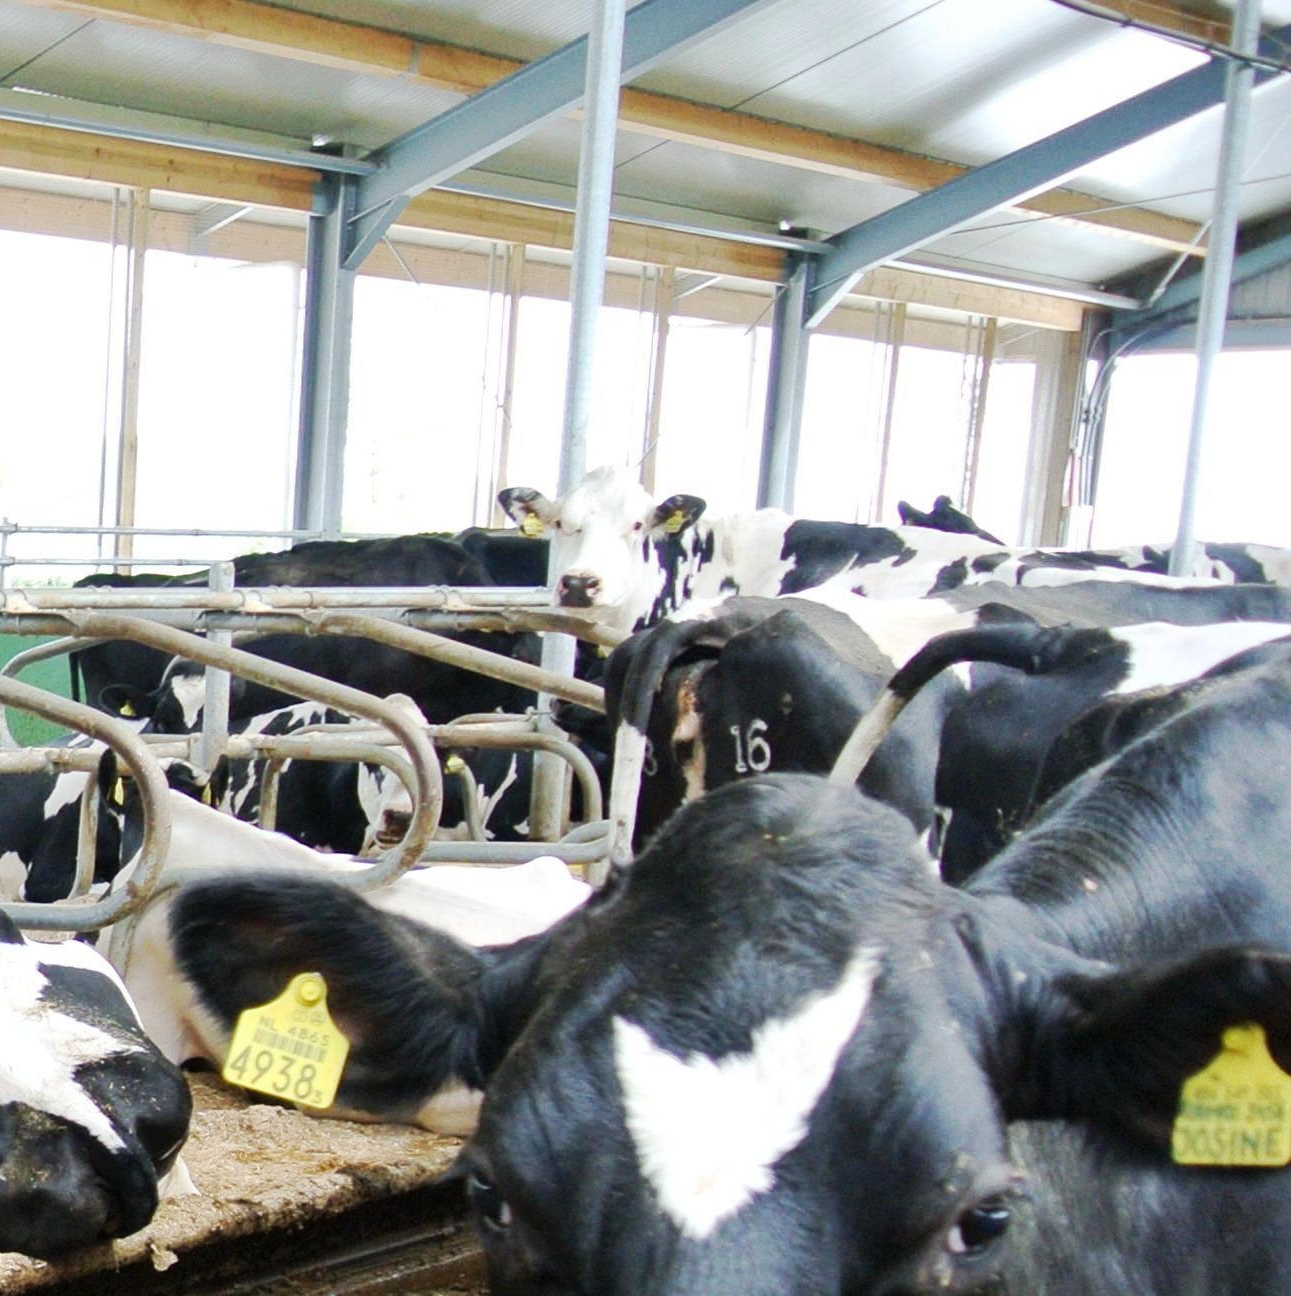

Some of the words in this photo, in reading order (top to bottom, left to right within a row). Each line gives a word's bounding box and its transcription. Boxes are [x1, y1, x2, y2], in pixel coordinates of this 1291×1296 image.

[730, 718, 771, 773] 16
[259, 1016, 278, 1031] NL
[288, 1026, 330, 1046] 4865
[230, 1046, 317, 1099] 4938
